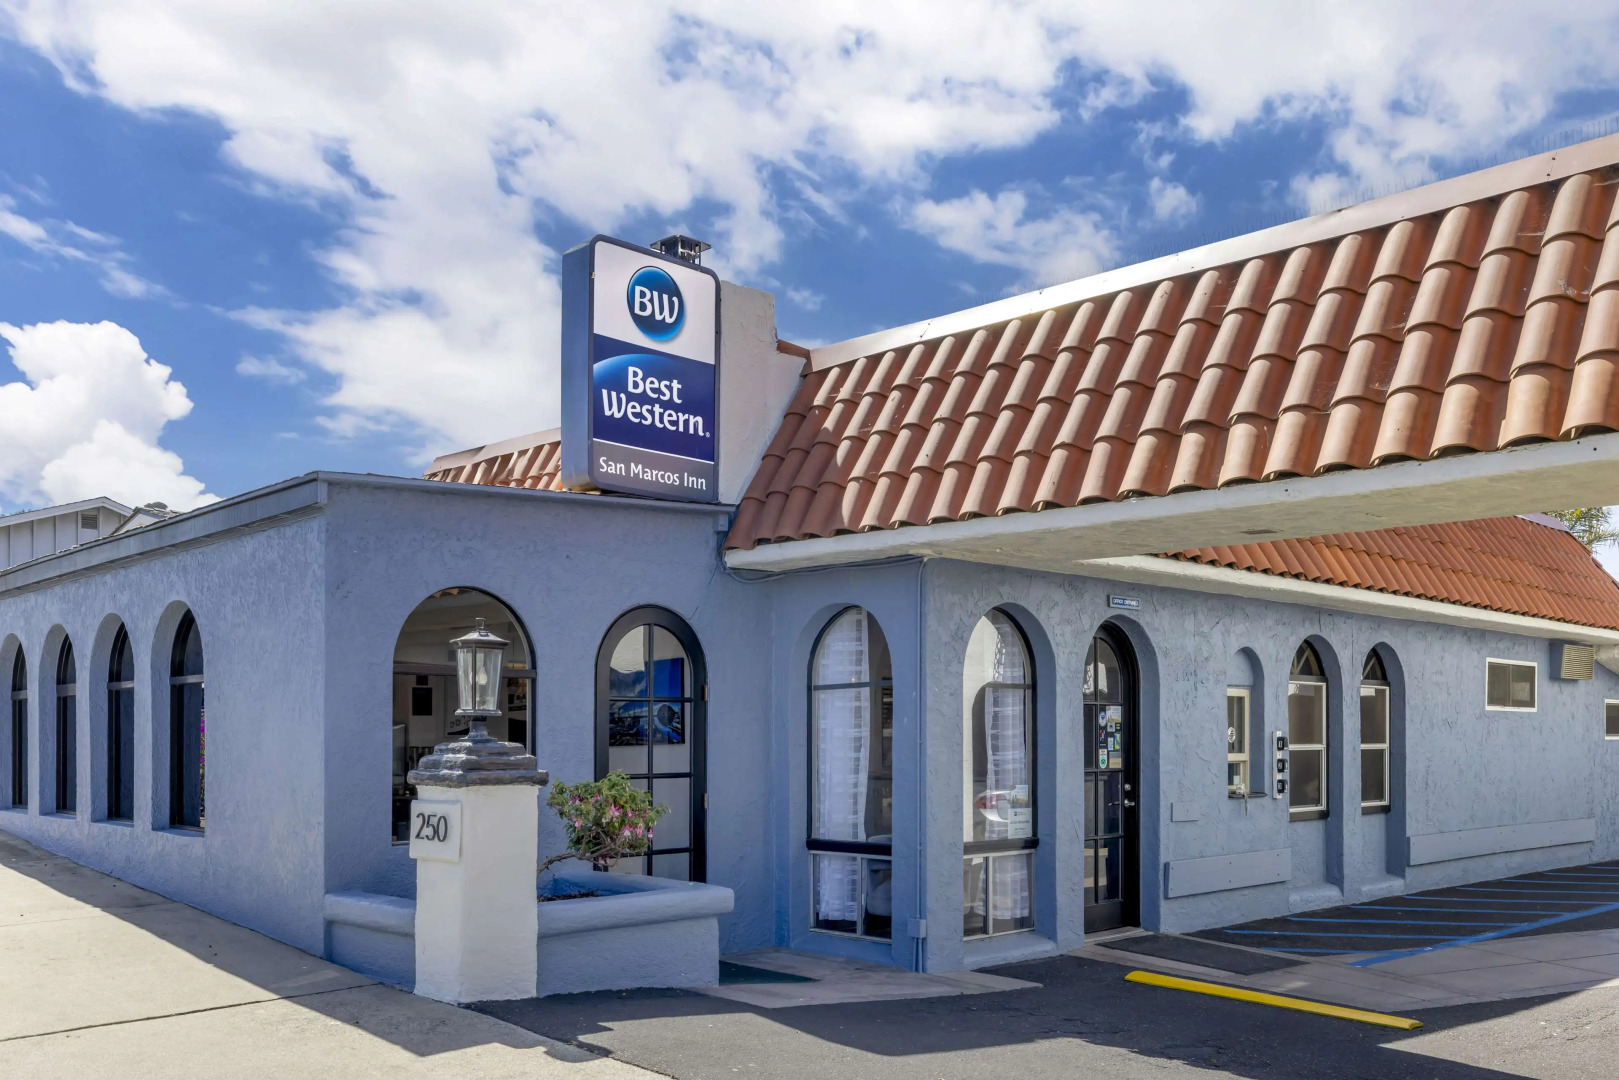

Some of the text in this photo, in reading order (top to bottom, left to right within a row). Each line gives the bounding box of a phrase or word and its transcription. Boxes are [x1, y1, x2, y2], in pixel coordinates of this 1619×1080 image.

[634, 285, 679, 324] BW
[628, 366, 682, 404] Best
[599, 456, 706, 490] San Marcos Inn
[415, 812, 448, 842] 250
